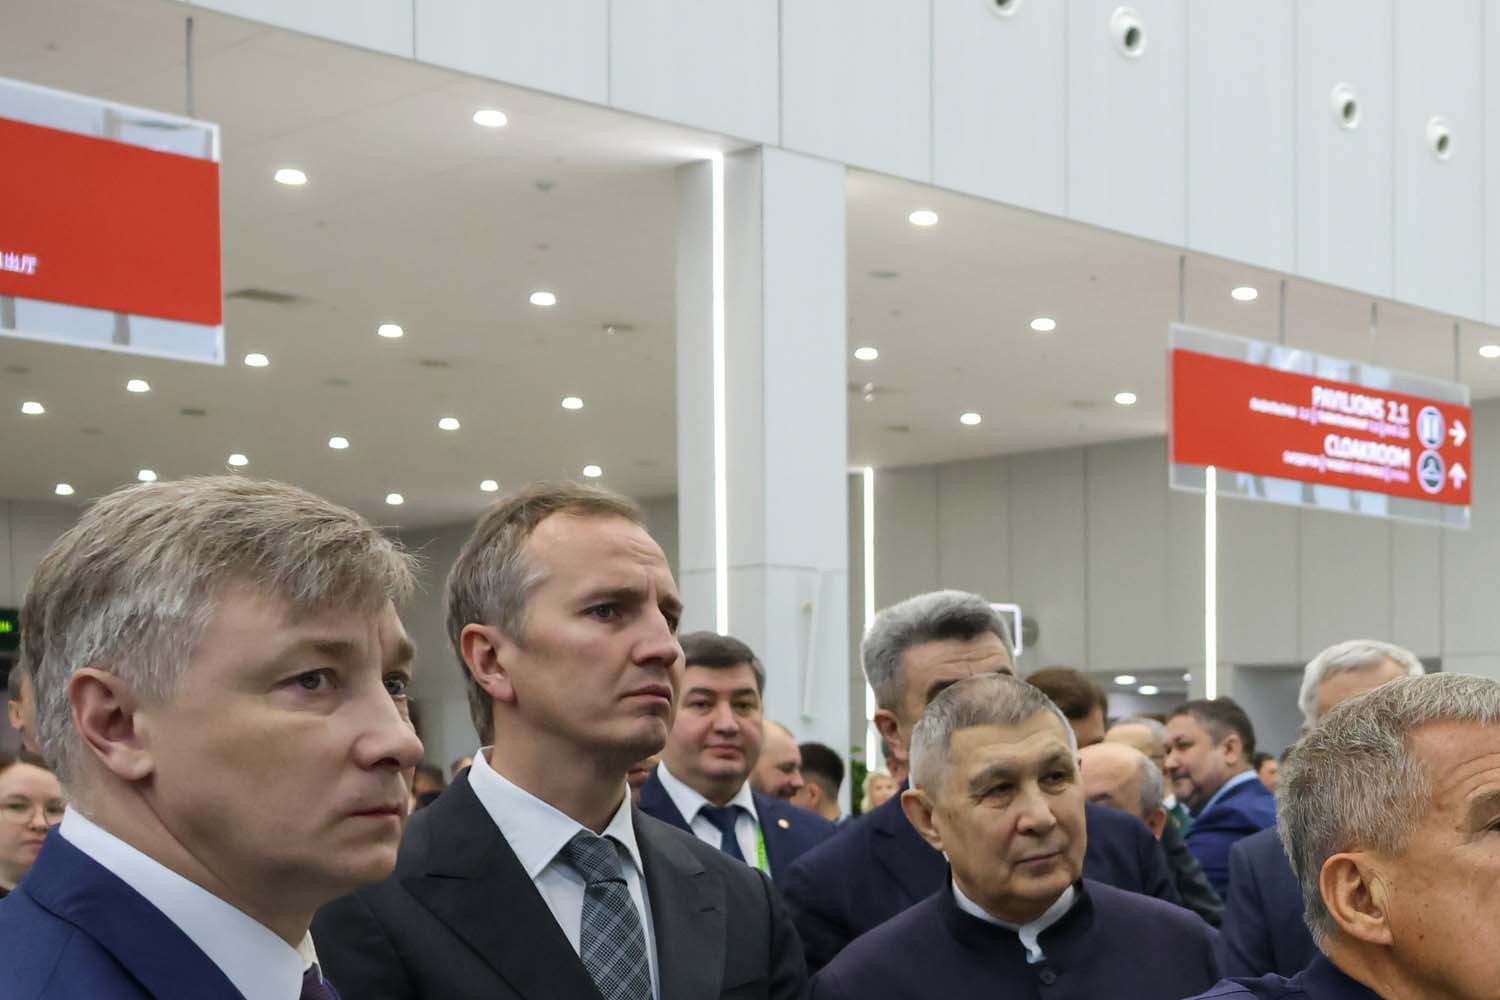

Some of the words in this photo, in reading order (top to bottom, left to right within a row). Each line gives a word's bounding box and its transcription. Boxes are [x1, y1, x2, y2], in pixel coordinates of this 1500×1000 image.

[0, 250, 37, 274] 出厅
[1312, 386, 1385, 419] PAVILIONS
[1324, 434, 1411, 468] CLOAKROOM
